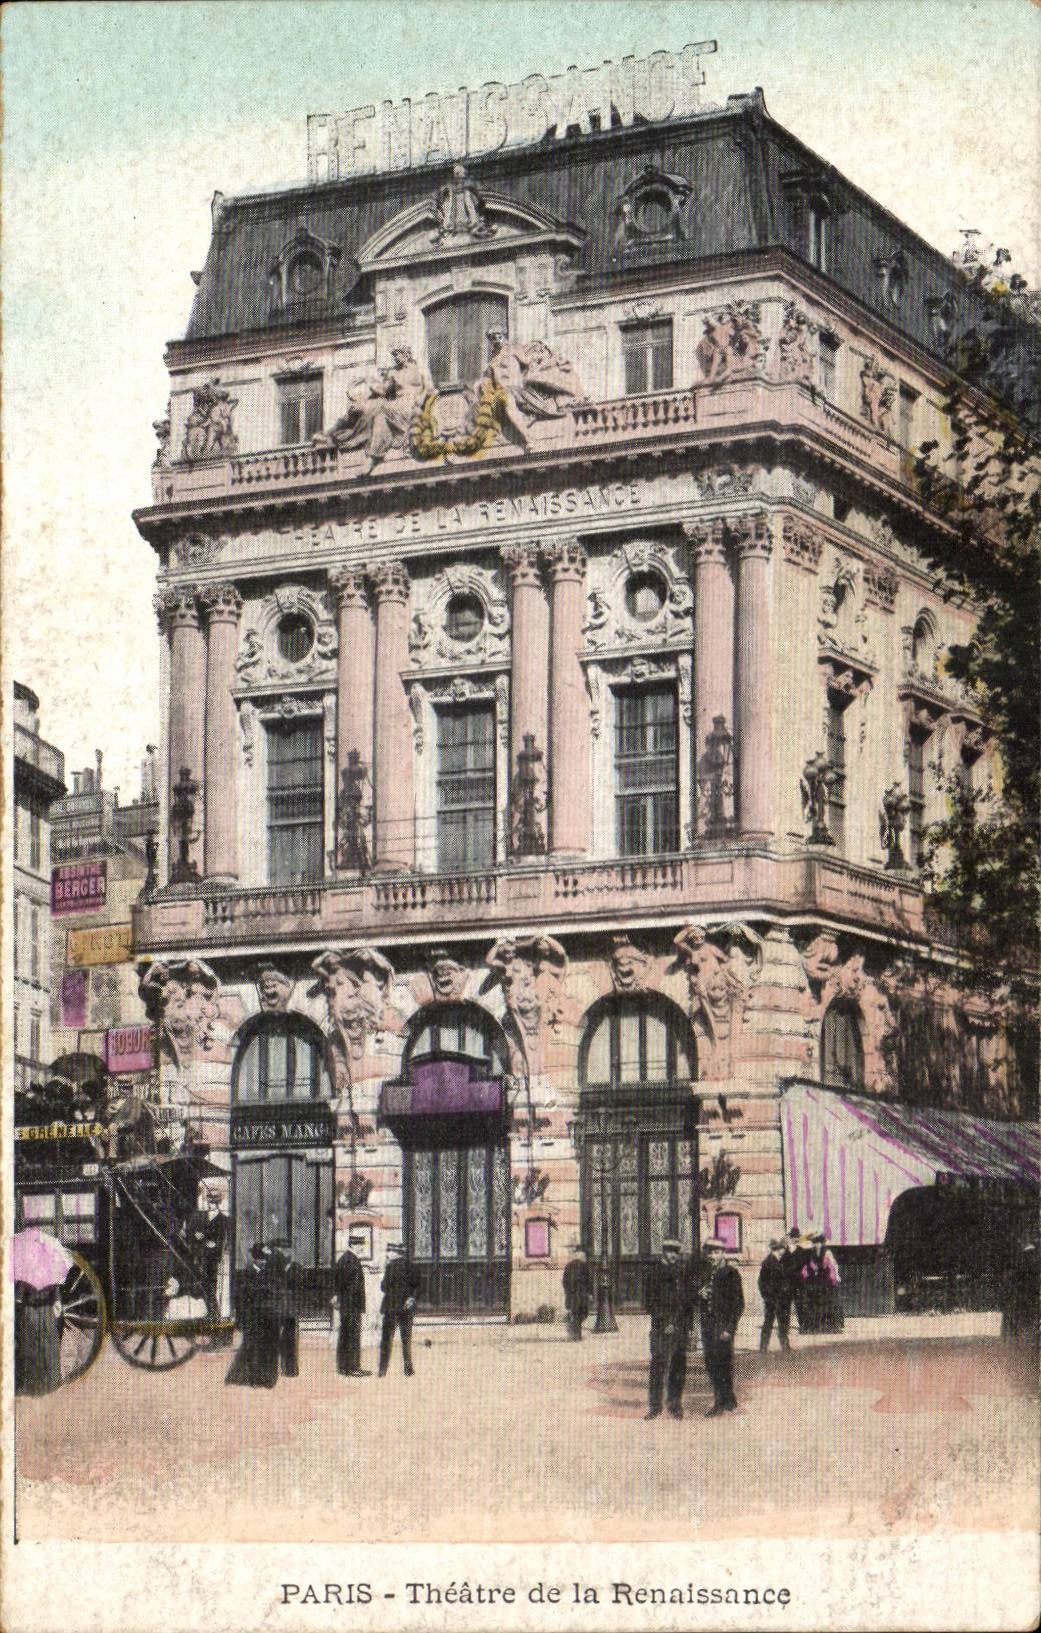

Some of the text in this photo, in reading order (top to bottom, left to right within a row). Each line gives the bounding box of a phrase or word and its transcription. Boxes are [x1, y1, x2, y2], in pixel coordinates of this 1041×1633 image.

[307, 40, 719, 183] RENAISSANCE
[437, 506, 463, 530] LA
[478, 484, 641, 522] RENAISSANCE
[54, 875, 106, 900] BERGER
[28, 1122, 95, 1139] GRENELLE
